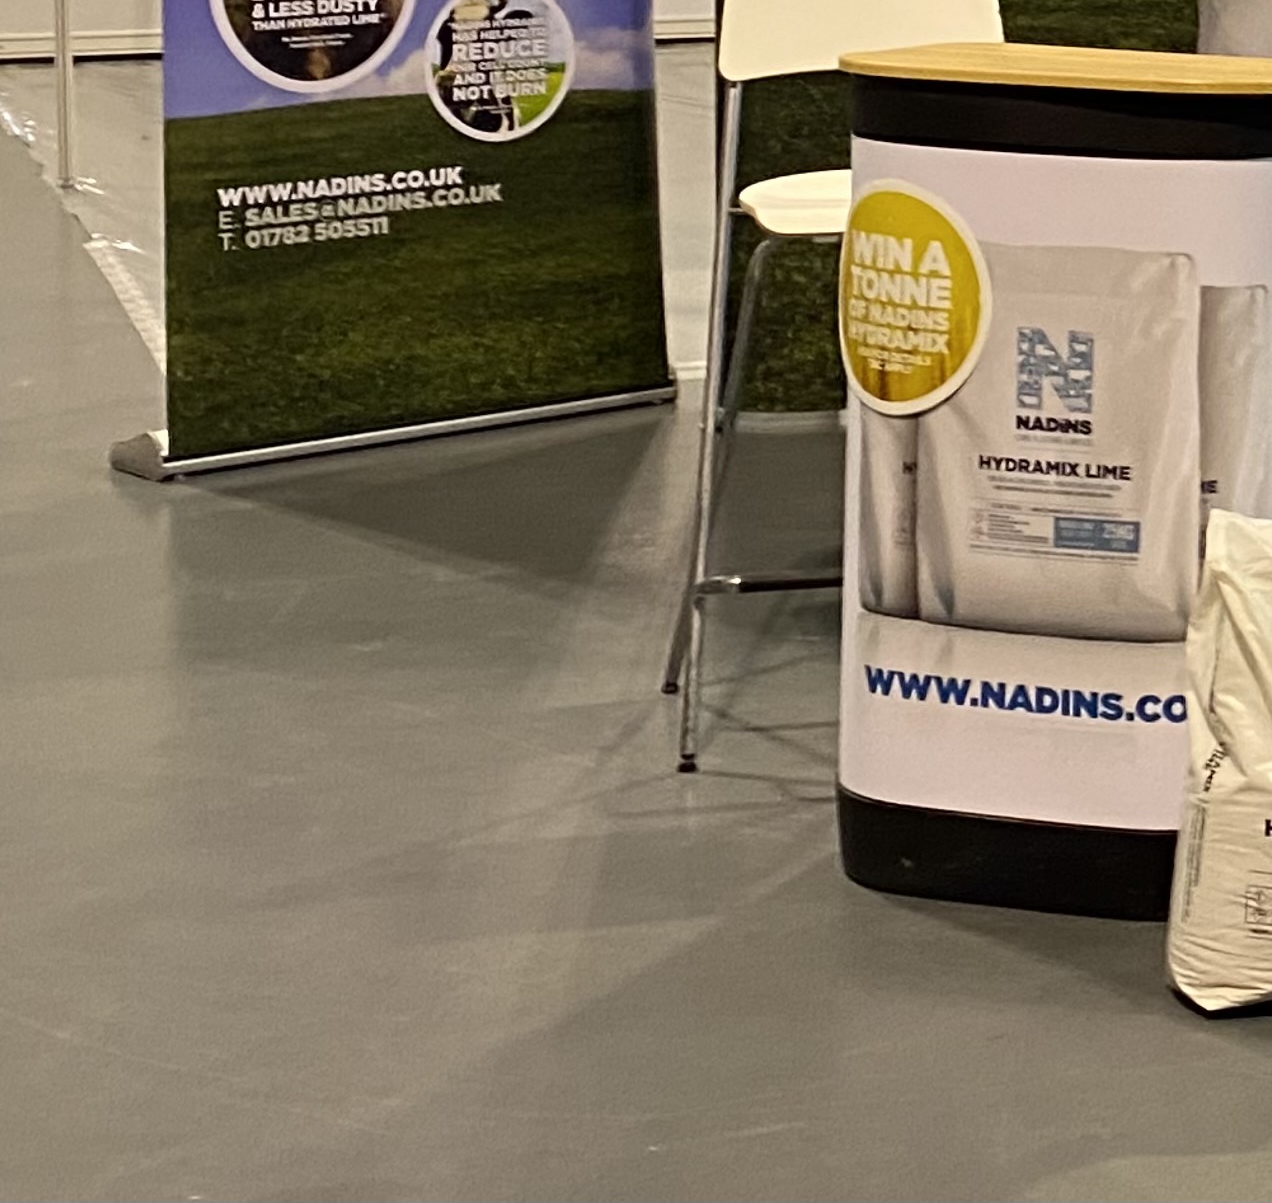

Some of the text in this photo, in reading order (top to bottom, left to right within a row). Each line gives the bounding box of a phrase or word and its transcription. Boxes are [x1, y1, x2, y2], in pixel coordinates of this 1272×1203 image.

[252, 3, 265, 19] &
[268, 0, 315, 18] LESS
[252, 19, 286, 31] THAN
[452, 39, 546, 62] REDUCE
[453, 82, 547, 102] NOT BURN
[217, 165, 463, 207] WWW.NADINS.CO.UK
[244, 183, 503, 227] SALES@NADINS.CO.UK
[245, 224, 310, 249] 01782
[314, 216, 388, 241] 505511
[851, 229, 952, 276] WIN A
[850, 264, 953, 310] TONNE
[867, 302, 950, 331] NADINS
[978, 454, 1131, 481] HYDRAMIX LIME
